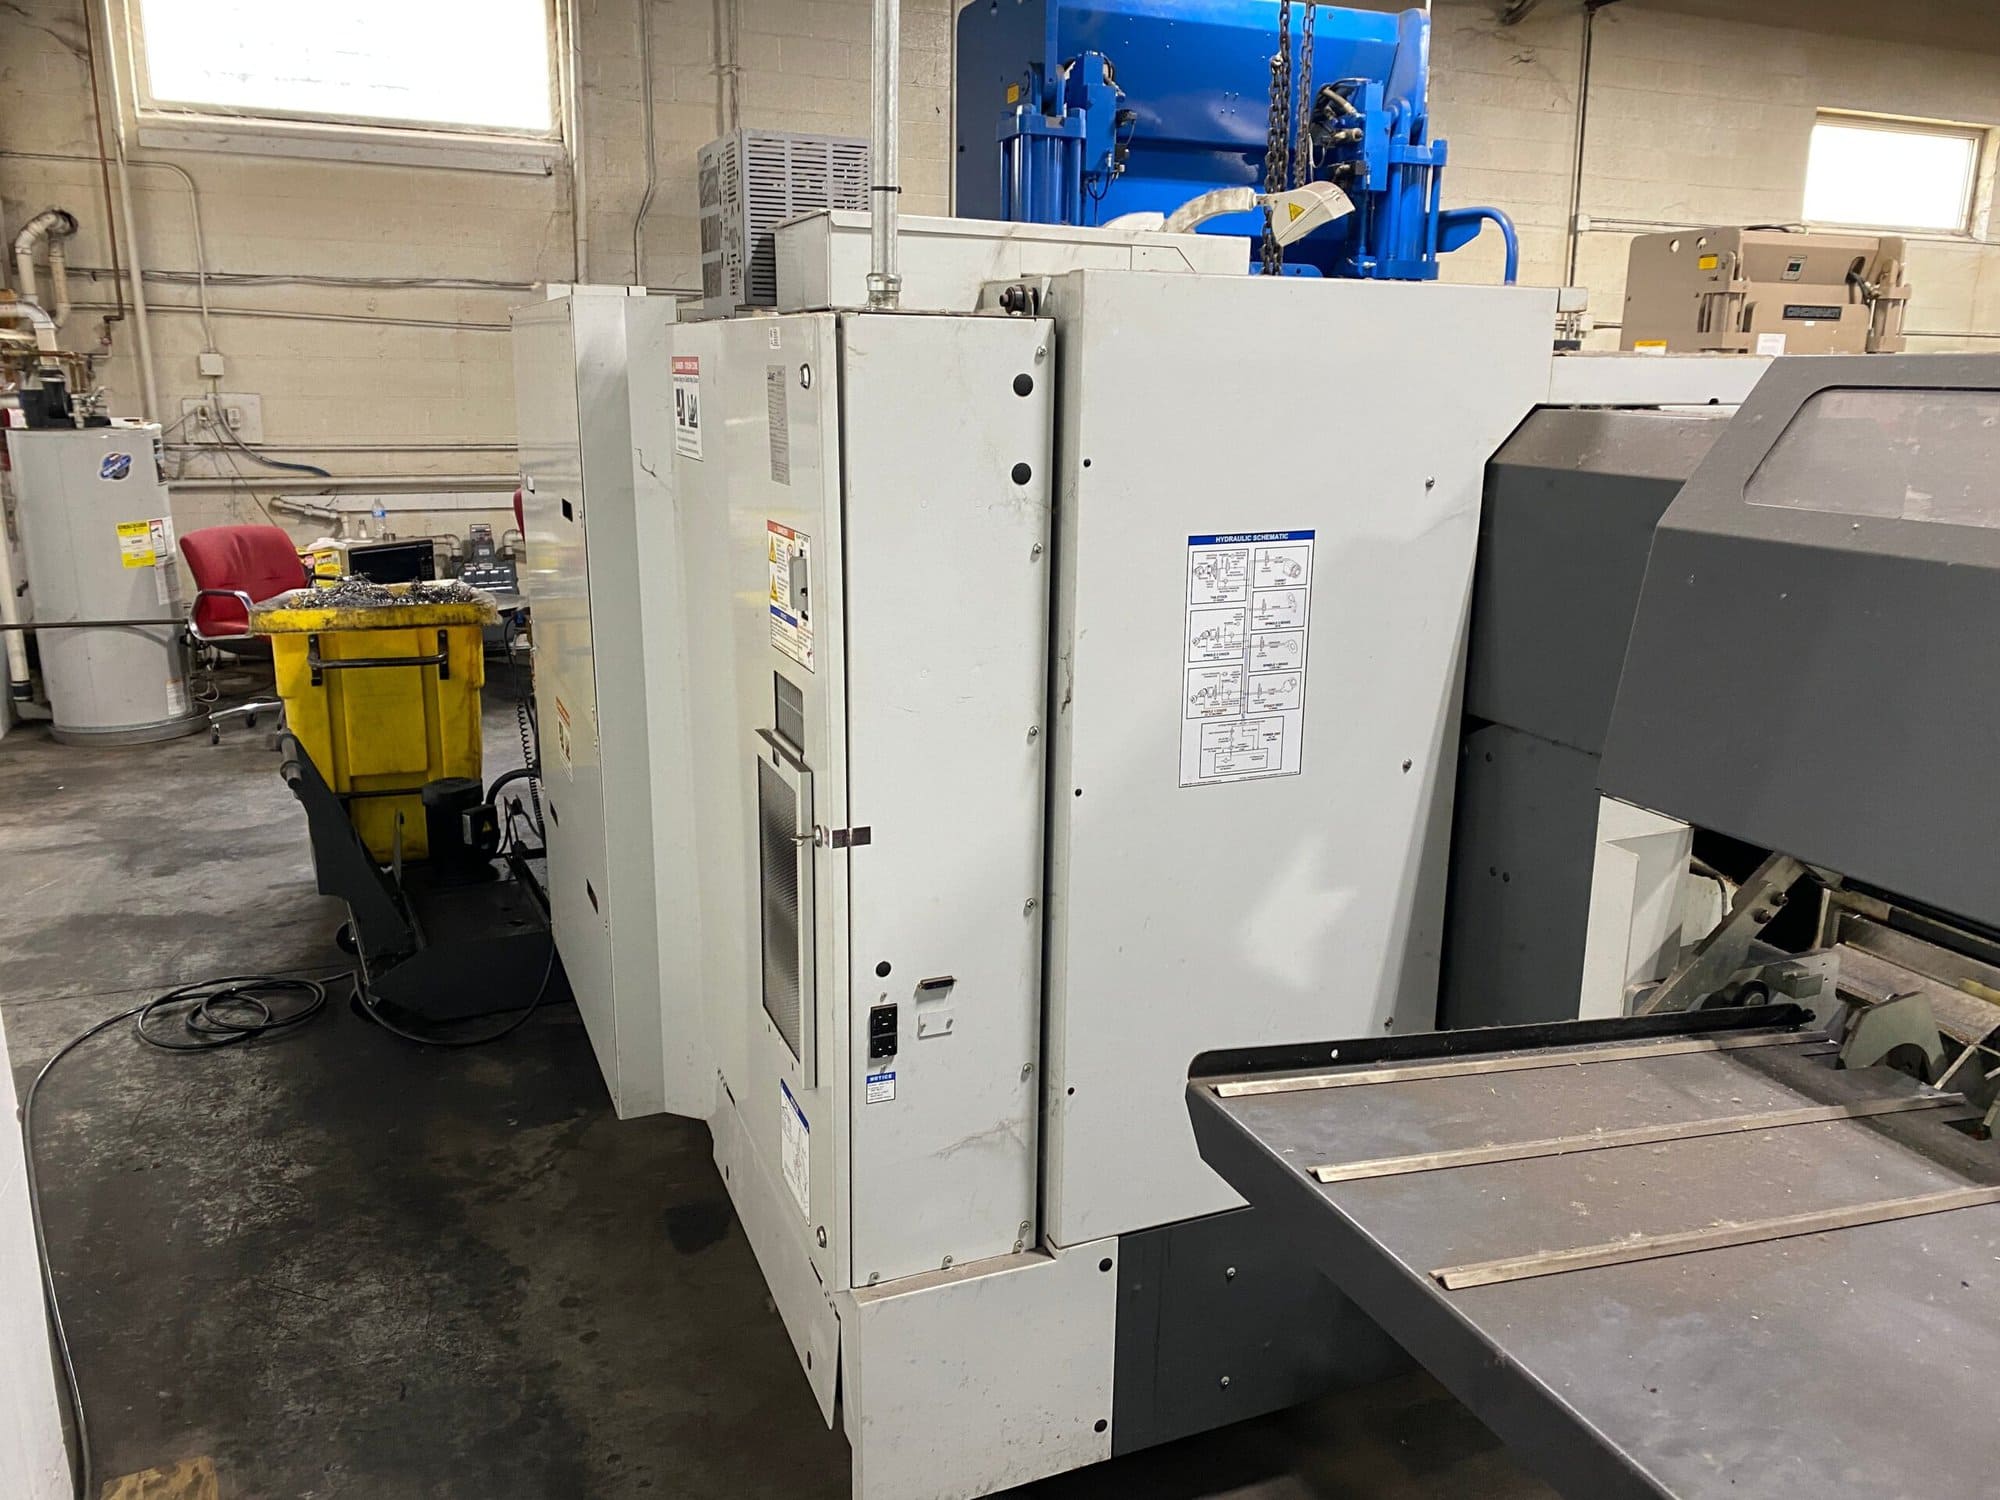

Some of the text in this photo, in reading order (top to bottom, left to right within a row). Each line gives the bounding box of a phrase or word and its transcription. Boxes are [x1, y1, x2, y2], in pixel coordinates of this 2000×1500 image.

[1215, 533, 1289, 543] HYDRAULIC SCHEMATIC
[869, 1073, 893, 1081] NOTICE
